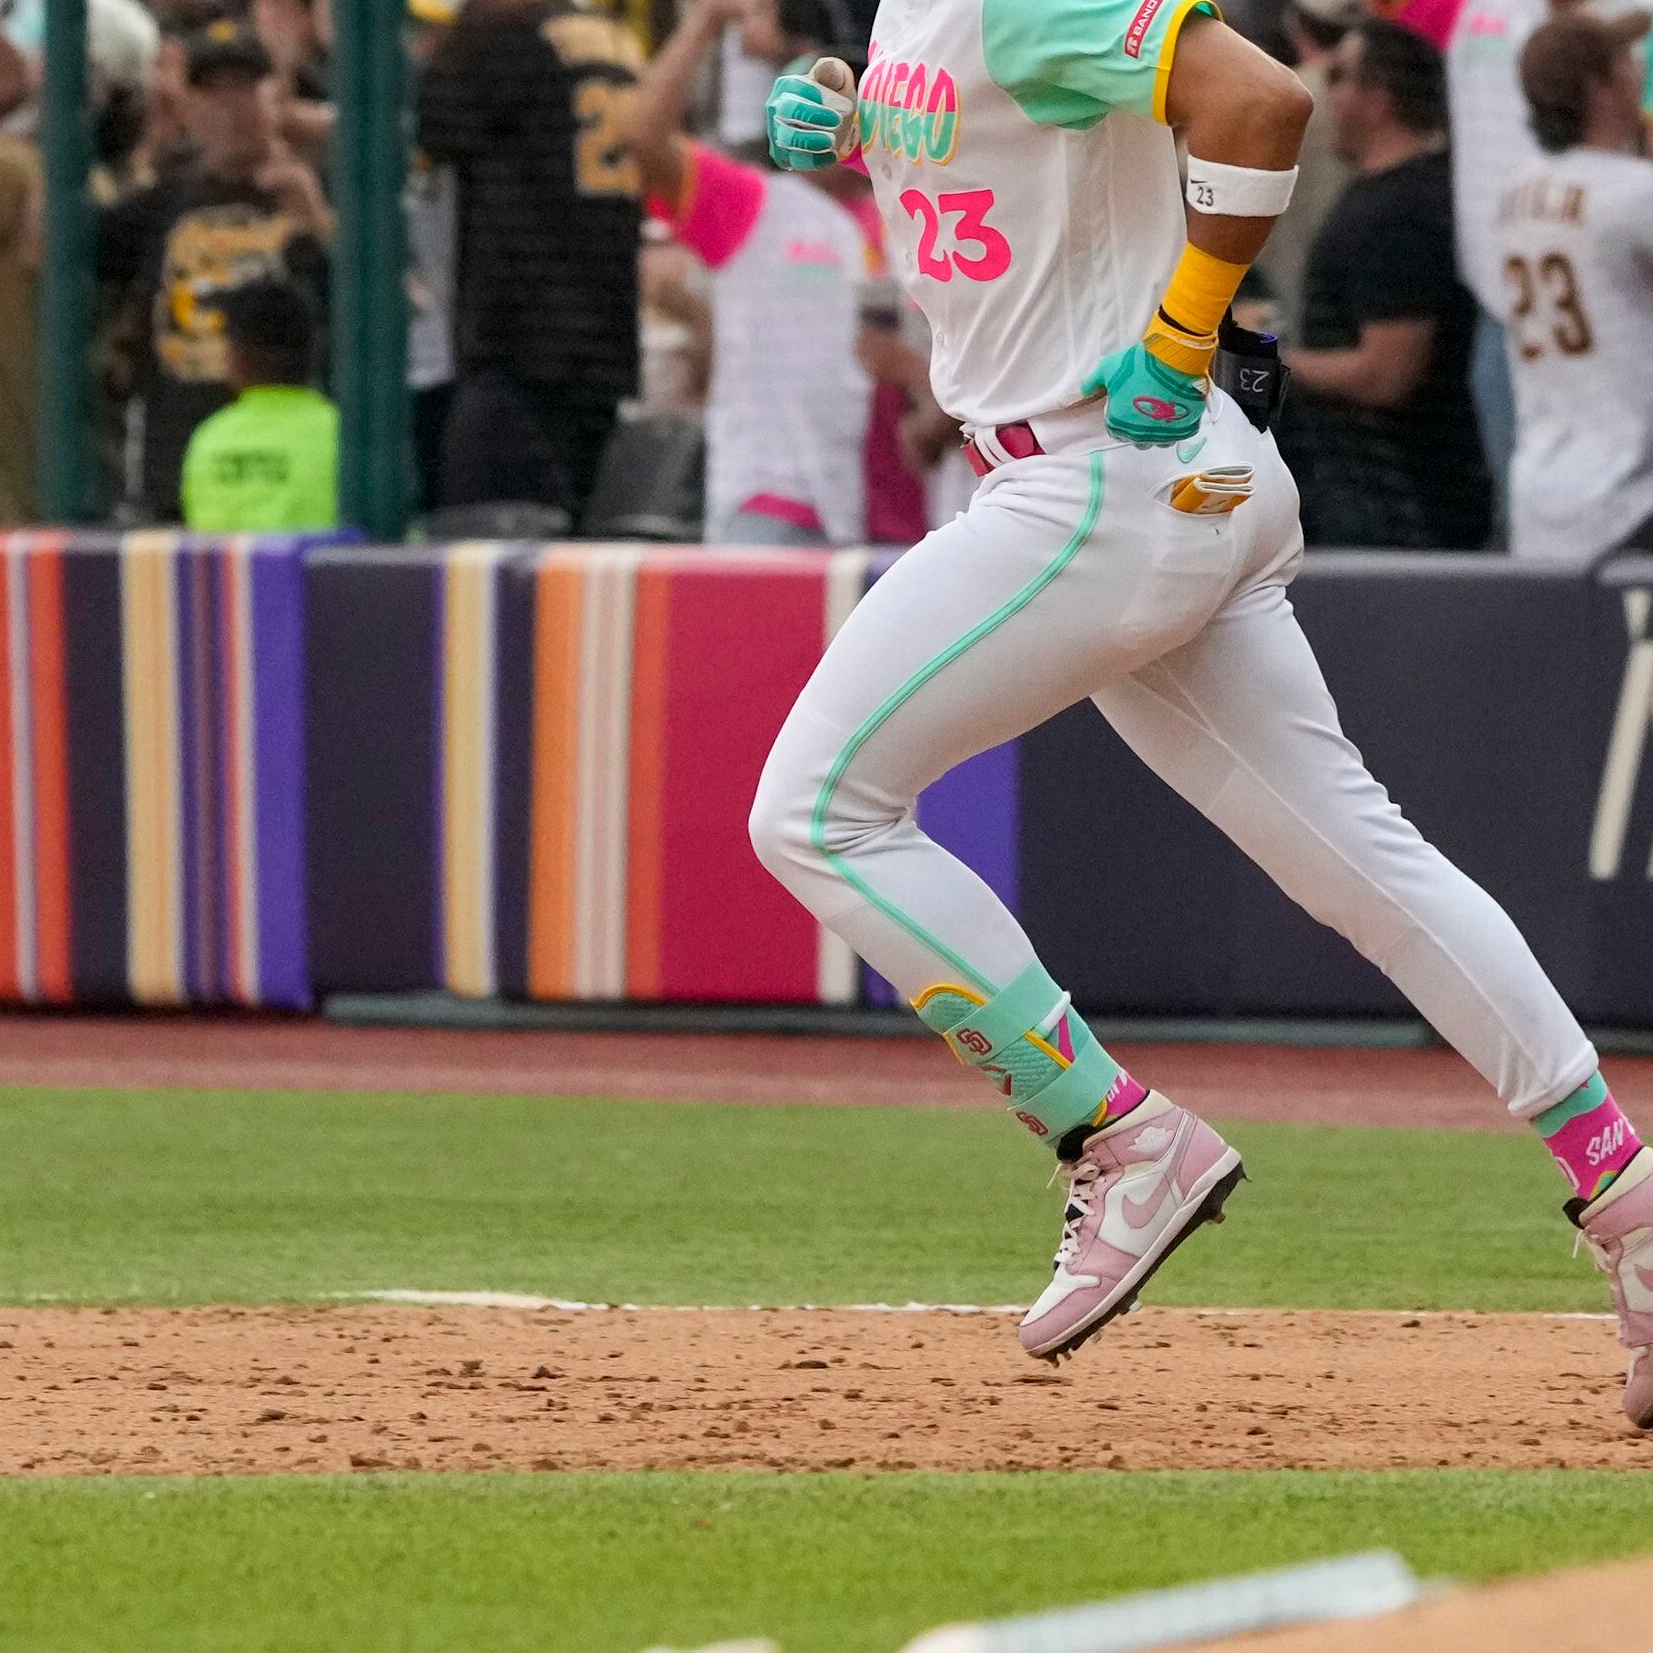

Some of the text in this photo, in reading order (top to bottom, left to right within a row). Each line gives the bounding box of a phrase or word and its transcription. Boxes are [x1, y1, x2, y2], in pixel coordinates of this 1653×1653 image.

[858, 59, 961, 166] DIEGO
[899, 189, 1012, 283] 23
[1196, 186, 1214, 207] 23
[1502, 251, 1594, 357] 23
[1585, 1117, 1625, 1167] SAN
